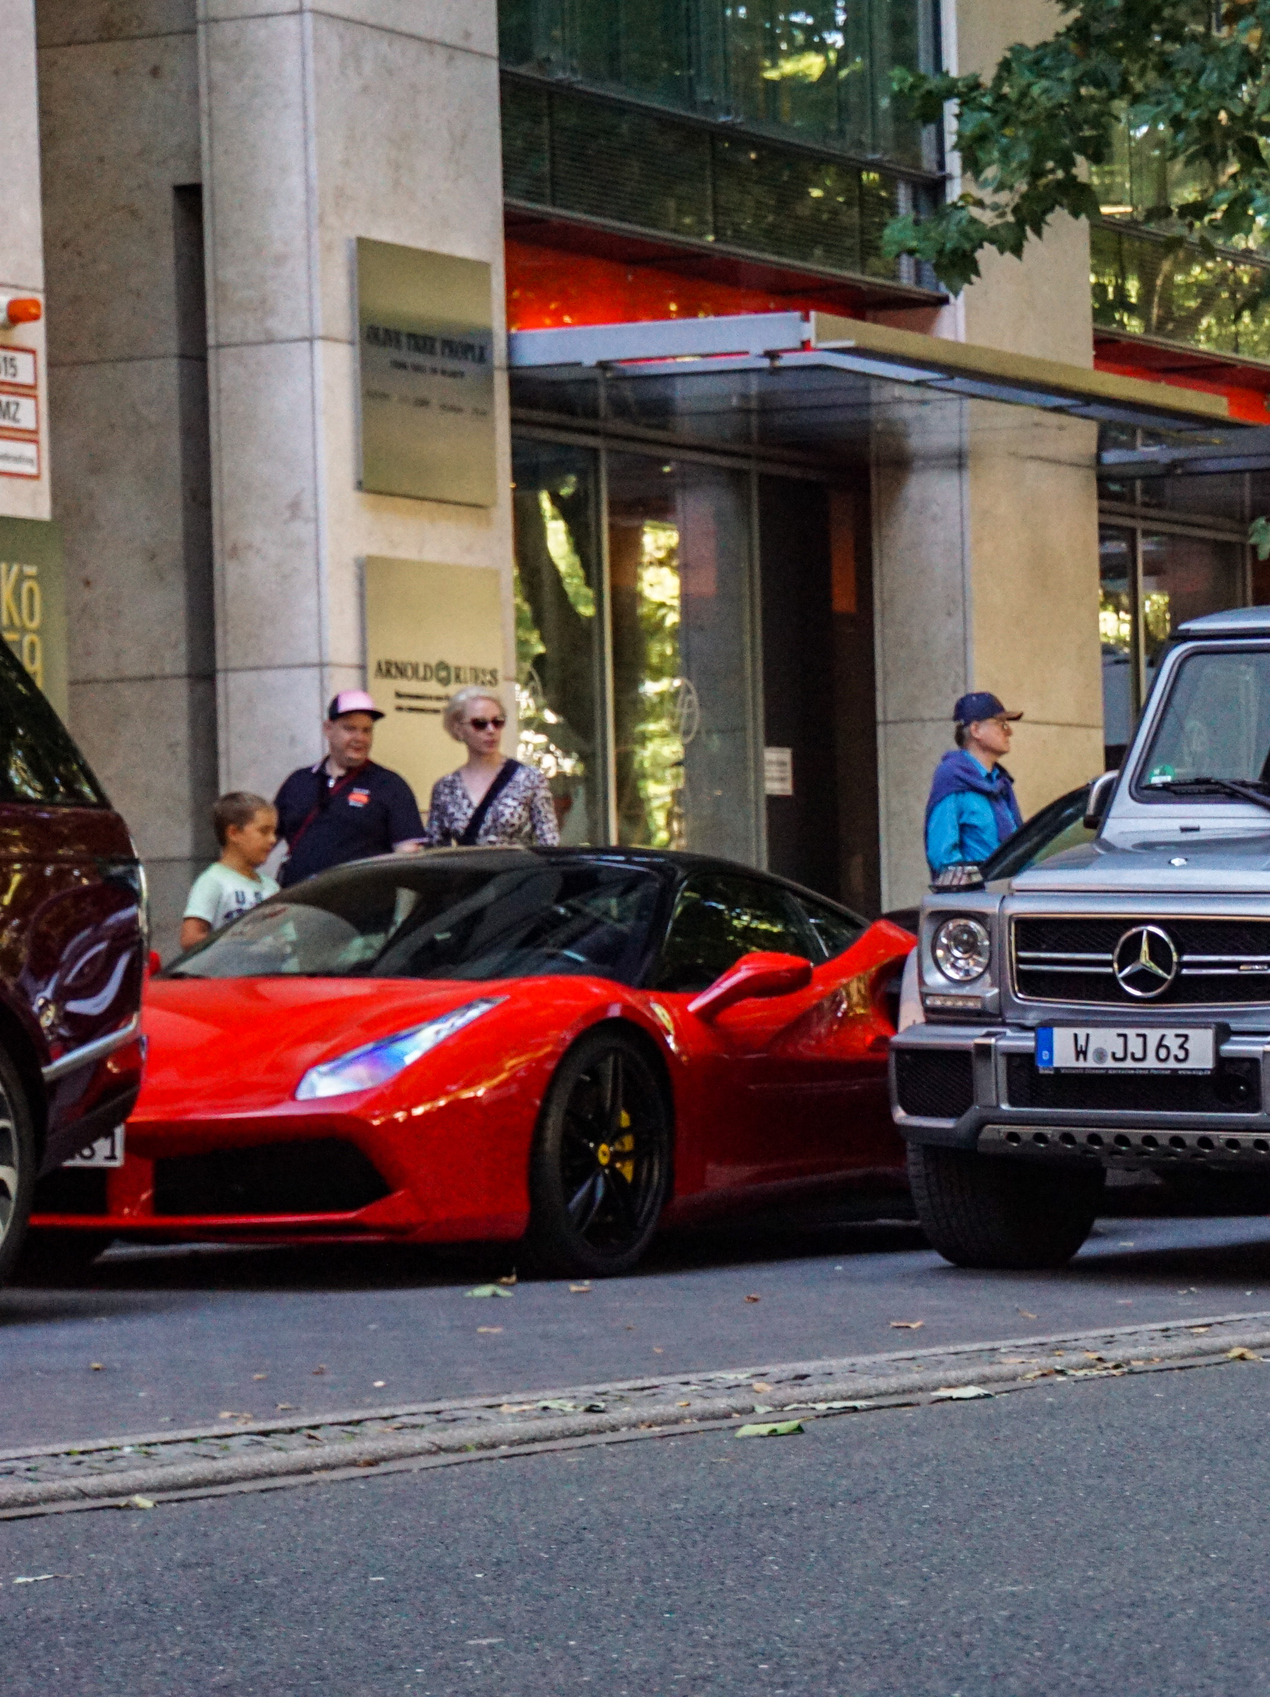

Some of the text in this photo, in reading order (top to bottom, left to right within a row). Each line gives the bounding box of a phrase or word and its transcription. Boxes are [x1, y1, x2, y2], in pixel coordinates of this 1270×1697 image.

[374, 659, 433, 683] ARNOLD
[1073, 1032, 1190, 1063] W JJ 63
